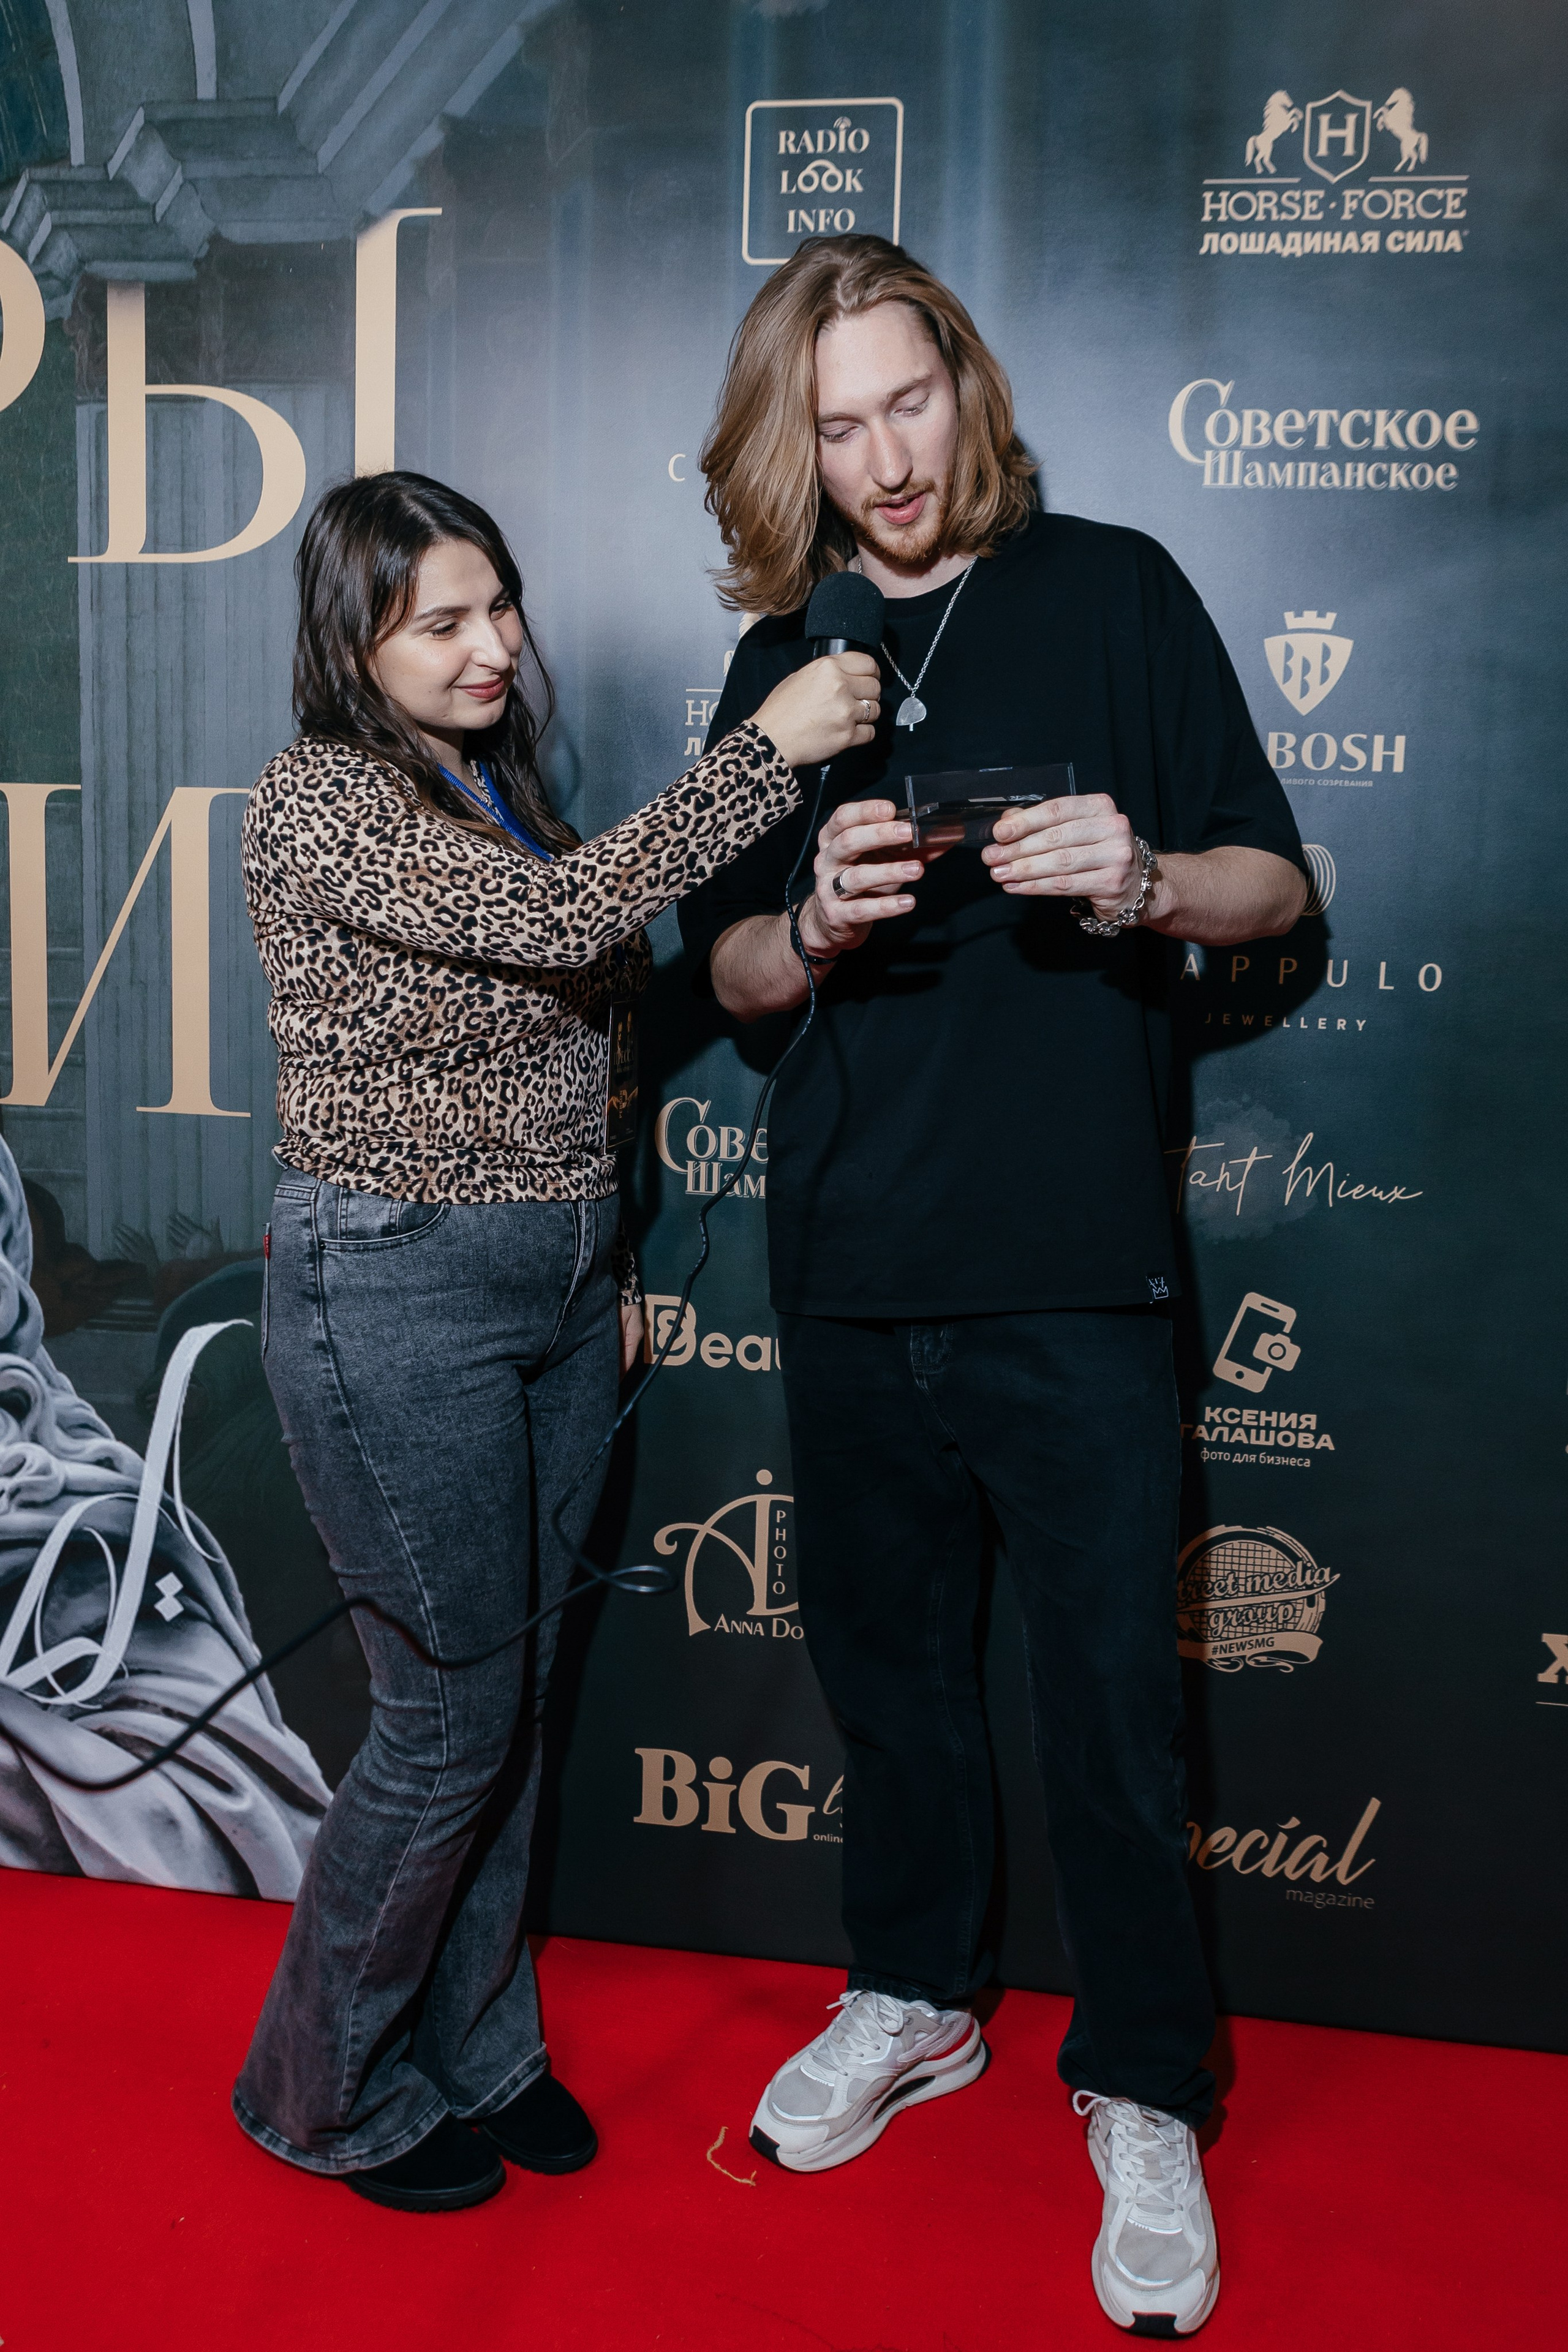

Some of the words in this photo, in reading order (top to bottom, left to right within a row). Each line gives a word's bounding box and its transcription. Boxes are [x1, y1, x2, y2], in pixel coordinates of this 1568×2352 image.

[777, 127, 870, 154] RADIO
[1316, 113, 1359, 157] H
[780, 159, 864, 194] LOOK
[786, 208, 856, 233] INFO
[1199, 230, 1381, 258] ЛОШАДИНАЯ
[1385, 230, 1464, 253] СИЛА
[0, 207, 443, 564] Ы
[1168, 378, 1480, 466] Советское
[1202, 449, 1460, 491] Шампанское
[1317, 778, 1373, 787] СОЗРЕВАНИЯ
[1204, 1012, 1367, 1031] JEWELLERY
[1283, 1132, 1423, 1208] Mieux
[643, 1294, 781, 1372] Bea
[1204, 1406, 1317, 1430] КСЕНИЯ
[1200, 1447, 1231, 1463] фото
[1232, 1452, 1257, 1464] для
[1259, 1452, 1311, 1468] бизнеса
[772, 1510, 786, 1595] PHOTO
[1246, 1561, 1332, 1593] media
[1209, 1602, 1296, 1637] group
[1212, 1636, 1275, 1656] #NEWSMG
[633, 1747, 815, 1841] BiG
[1286, 1889, 1375, 1909] magazine
